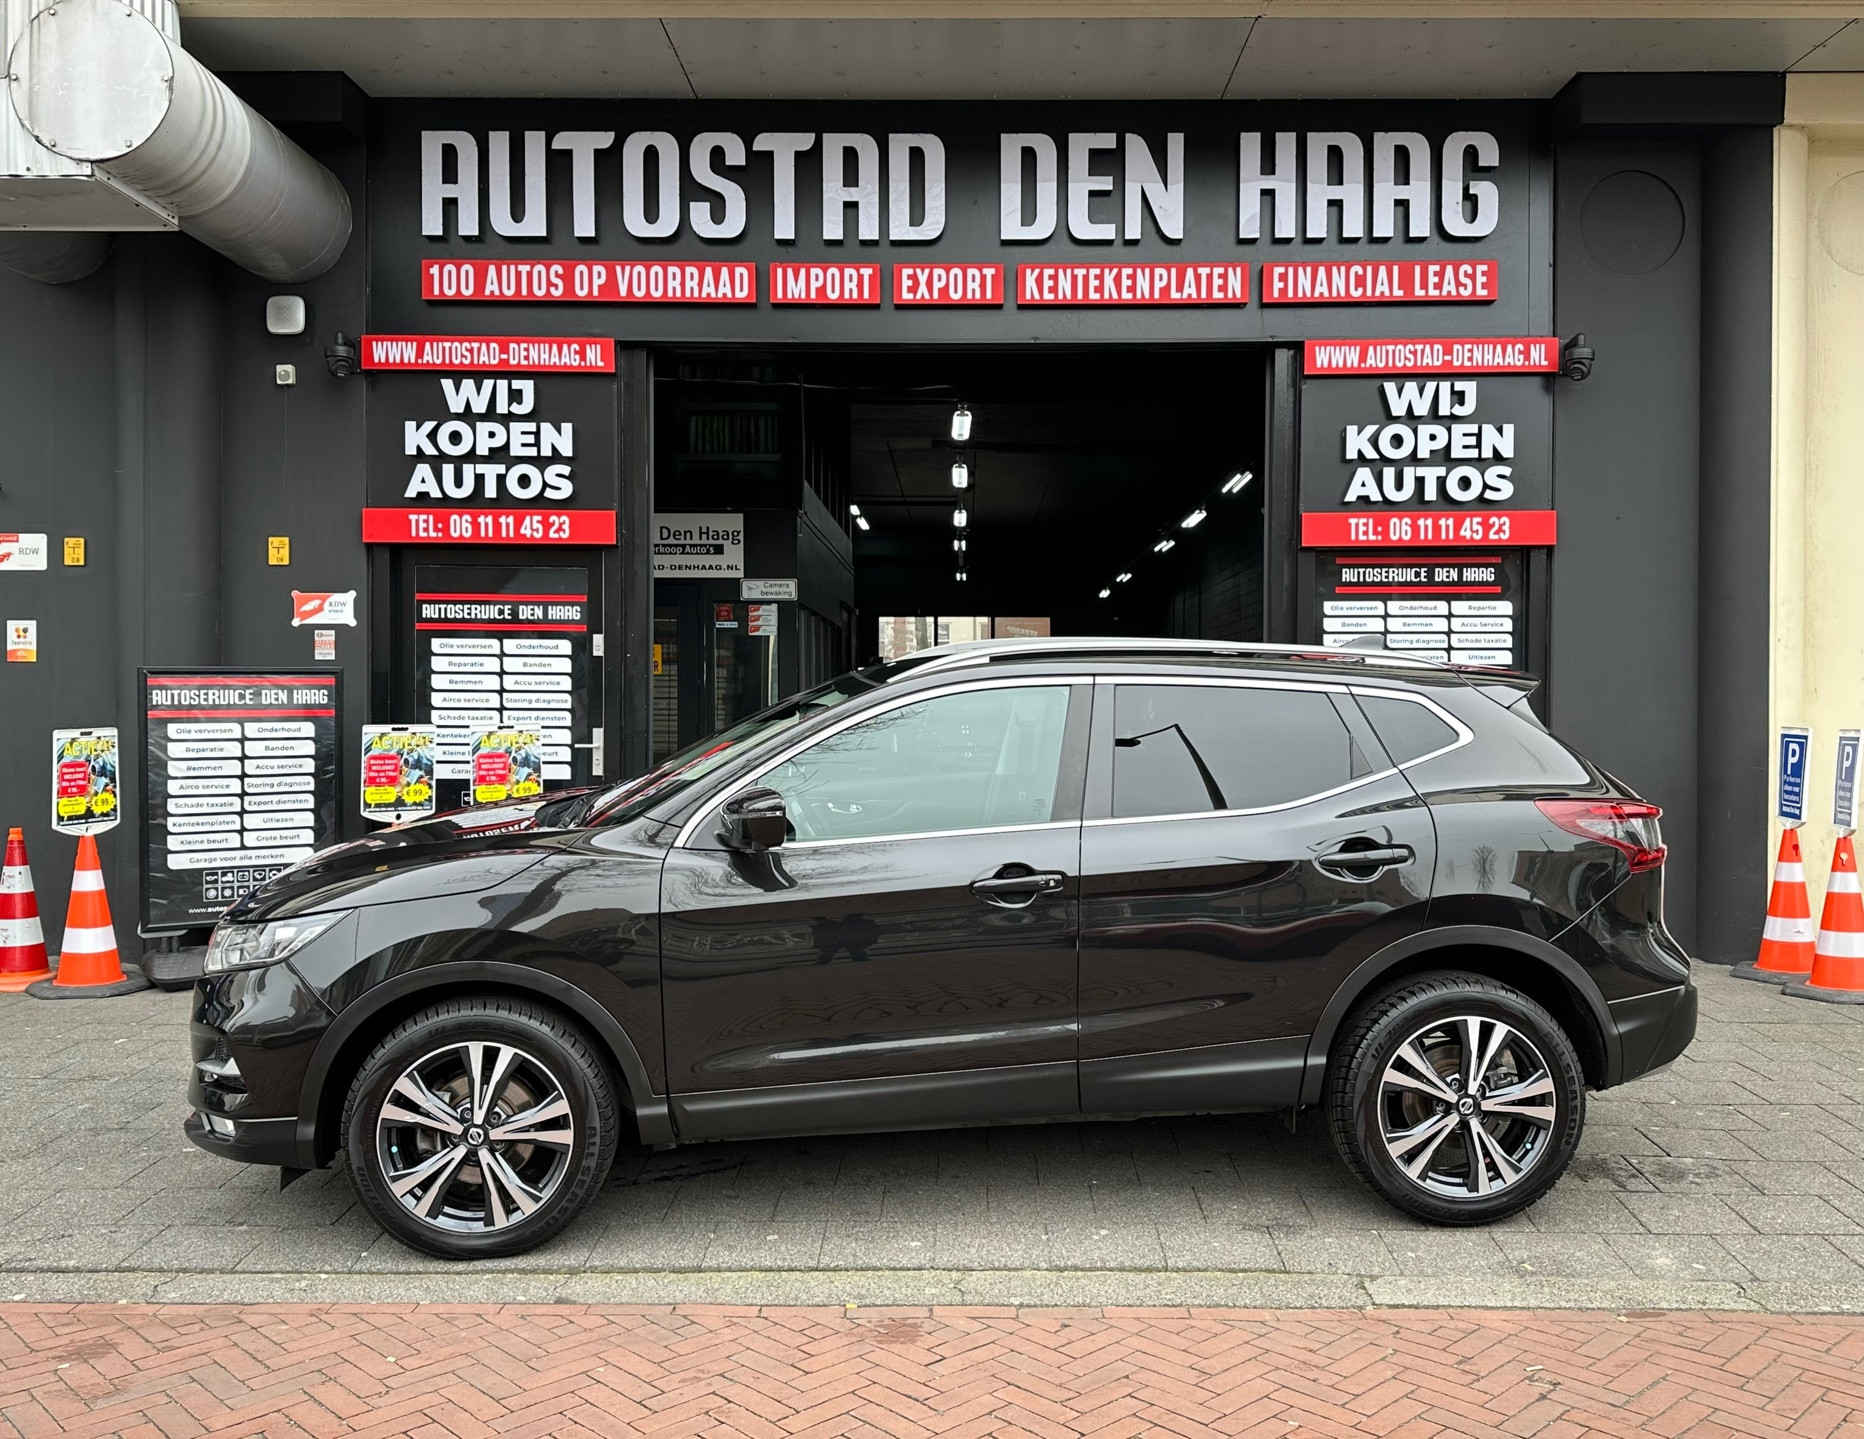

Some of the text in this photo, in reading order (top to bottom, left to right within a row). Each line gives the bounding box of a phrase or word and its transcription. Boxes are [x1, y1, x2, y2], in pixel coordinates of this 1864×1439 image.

[421, 130, 1500, 242] AUTOSTAD DEN HAAG
[430, 263, 750, 300] 100 AUTOS OP VOORRAAD
[775, 266, 874, 300] IMPORT
[901, 266, 996, 300] EXPORT
[1025, 265, 1244, 300] KENTEKENPLATEN
[1272, 263, 1490, 298] FINANCIAL LEASE
[371, 341, 604, 368] WWW.AUTOSTAD-DENHAAG.NL
[1314, 343, 1550, 368] WWW.AUTOSTAD-DENHAAG.NL
[440, 379, 536, 414] WIJ
[1383, 381, 1478, 416] WIJ
[404, 421, 574, 458] KOPEN
[1345, 424, 1516, 460] KOPEN
[404, 463, 574, 500] AUTOS
[1344, 466, 1516, 502] AUTOS
[408, 514, 570, 538] TEL: 06 11 11 45 23
[659, 526, 742, 546] Den Haag
[1348, 516, 1510, 542] TEL: 06 11 11 45 23
[18, 548, 40, 556] RDW
[684, 545, 714, 554] Auto's
[1342, 567, 1496, 582] AUTOSERVICE DEN HAAG
[760, 590, 792, 598] bewaking
[422, 604, 582, 620] AUTOSERVICE DEN HAAG
[1389, 638, 1446, 646] Storing diagnose
[152, 689, 328, 706] AUTOSERVICE DEN HAAG
[505, 697, 568, 705] Storing diagnose
[257, 726, 302, 734] Onderhoud
[185, 746, 224, 754] Reparatie
[1787, 742, 1800, 775] P
[1842, 745, 1852, 780] P
[247, 780, 312, 790] Storing diagnose
[248, 798, 310, 807] Export diensten
[172, 819, 236, 828] Kentekenplaten
[180, 838, 205, 846] Kleine
[189, 857, 218, 865] Garage
